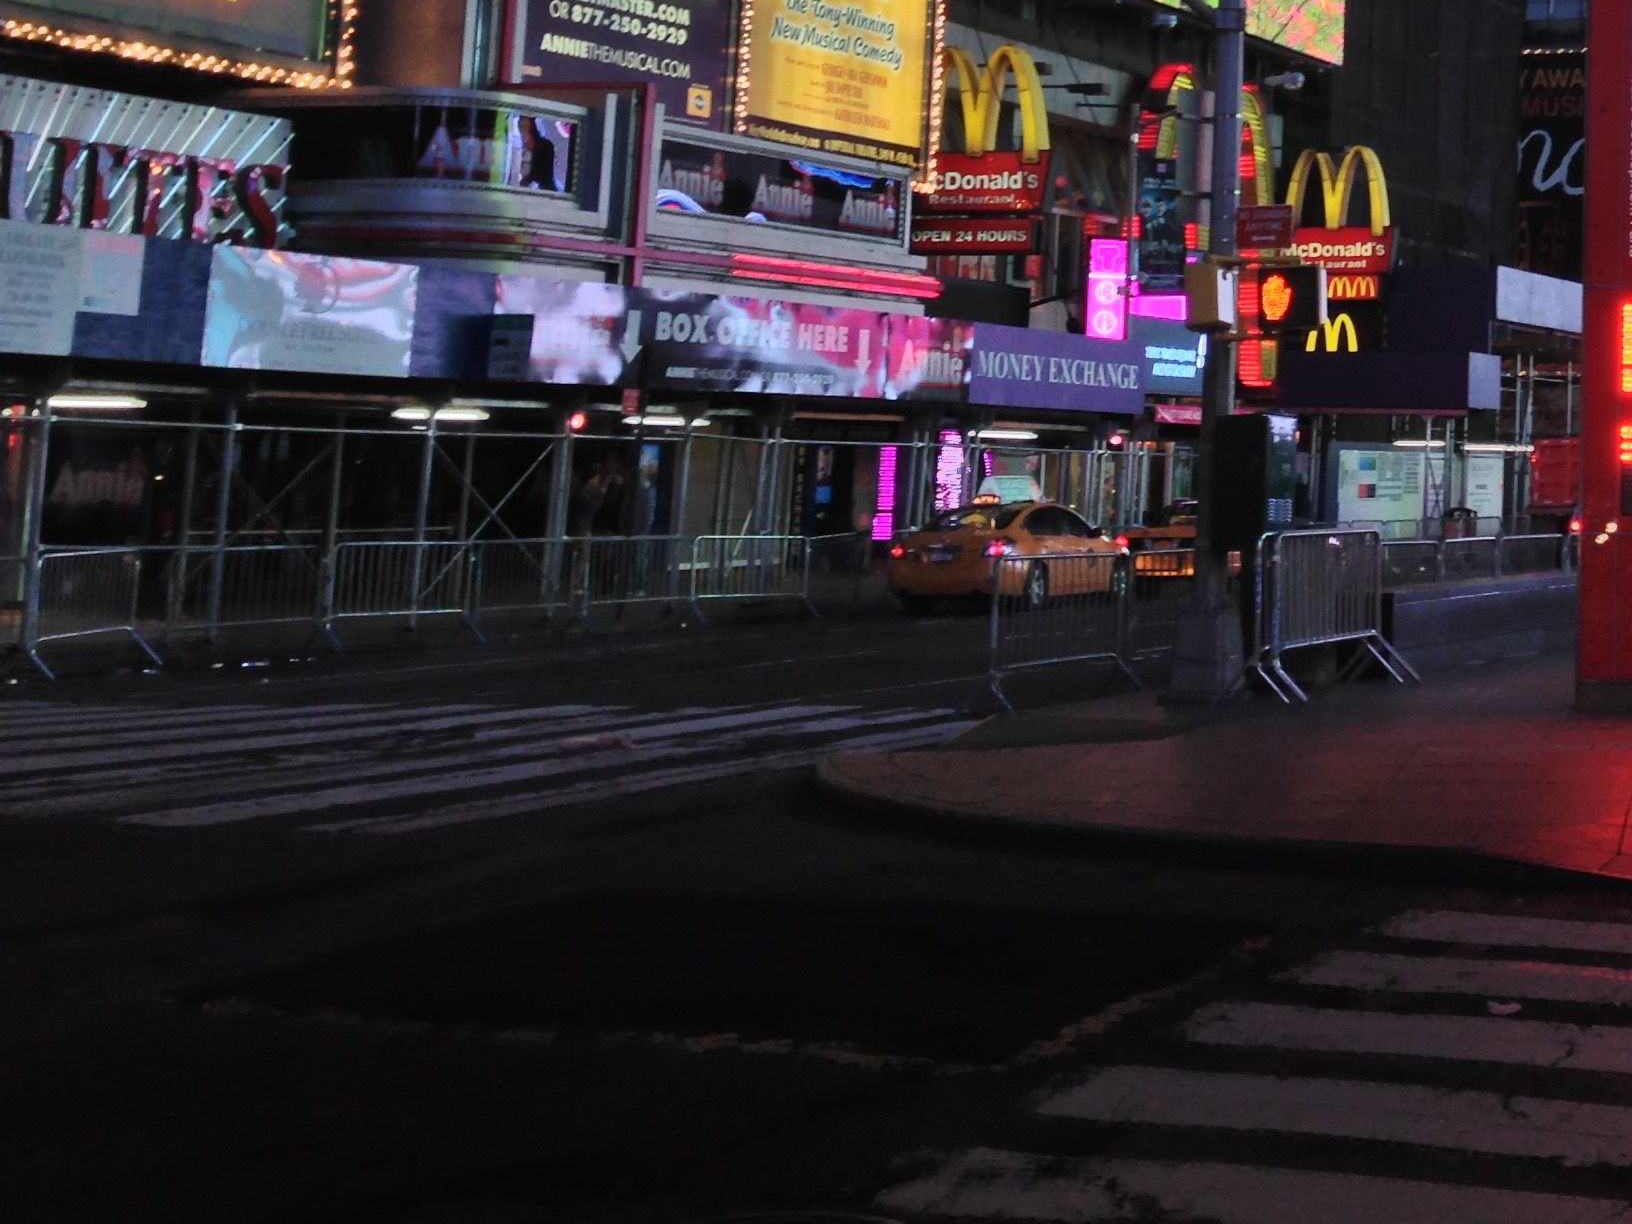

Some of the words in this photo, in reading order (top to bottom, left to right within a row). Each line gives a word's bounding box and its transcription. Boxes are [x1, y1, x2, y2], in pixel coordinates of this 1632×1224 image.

[549, 0, 569, 21] OR
[571, 2, 688, 45] 877-250-2929
[771, 16, 800, 41] New
[800, 21, 850, 55] Musical
[851, 36, 902, 71] Comedy
[540, 33, 691, 80] ANNIETHEMUSICAL.COM
[934, 170, 1038, 191] cDonald's
[912, 229, 951, 244] OPEN
[955, 229, 974, 244] 24
[976, 229, 1028, 243] HOURS
[1280, 241, 1385, 257] McDonald's
[655, 311, 708, 344] BOX
[717, 317, 791, 350] OFFICE
[799, 324, 849, 353] HERE
[979, 348, 1045, 382] MONEY
[1049, 355, 1139, 391] EXCHANGE
